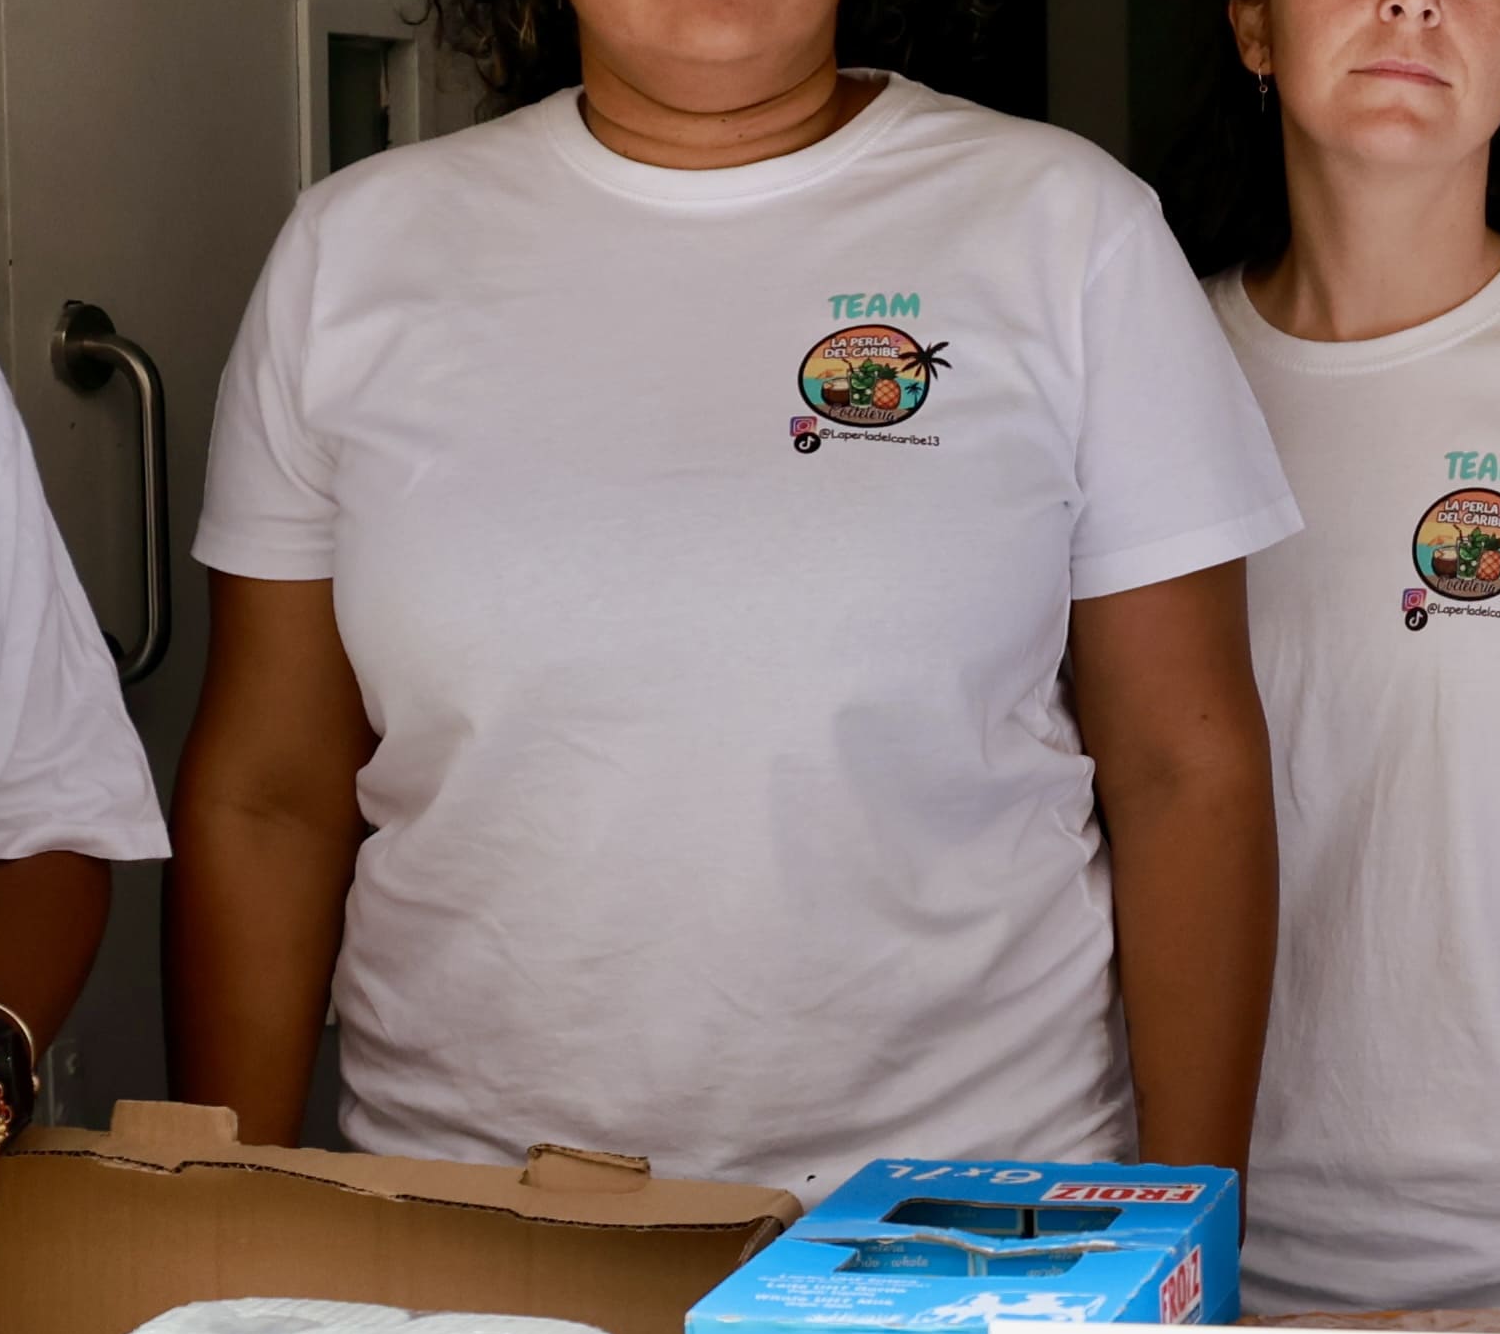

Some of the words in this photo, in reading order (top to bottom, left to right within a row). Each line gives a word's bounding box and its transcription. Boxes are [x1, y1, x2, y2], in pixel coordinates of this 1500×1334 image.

[828, 292, 921, 320] TEAM
[831, 337, 847, 348] LA
[850, 336, 890, 348] PERLA
[824, 348, 848, 359] DEL
[852, 347, 900, 359] CARIBE
[819, 428, 940, 447] @Laperladelcaribe13
[1445, 500, 1460, 512] LA
[1462, 501, 1499, 515] PERLA
[1437, 511, 1460, 524] DEL
[1051, 1186, 1196, 1202] FROIZ
